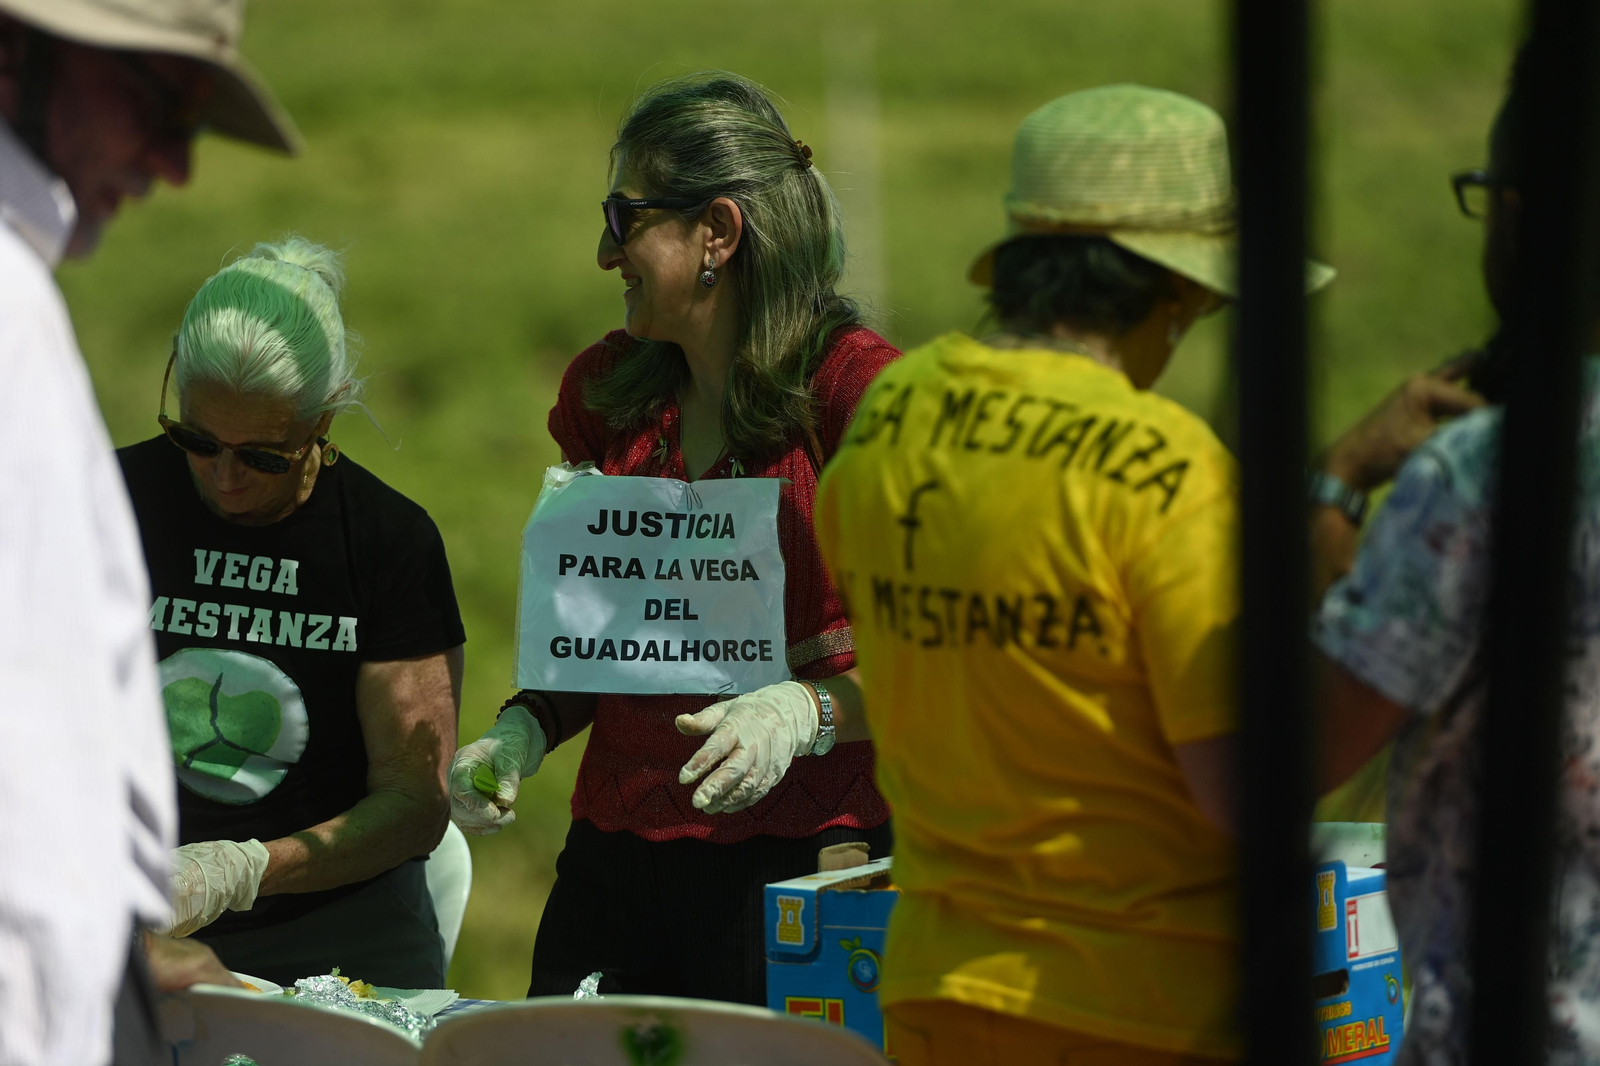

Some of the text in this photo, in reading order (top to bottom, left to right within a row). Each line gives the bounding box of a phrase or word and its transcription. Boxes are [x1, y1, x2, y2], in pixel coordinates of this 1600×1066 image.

[928, 387, 1190, 514] MESTANZA
[586, 508, 736, 540] JUSTICIA
[193, 548, 300, 596] VEGA
[558, 553, 760, 582] PARA LA VEGA
[644, 598, 699, 621] DEL
[550, 636, 773, 662] GUADALHORCE
[1316, 1000, 1352, 1022] TRICOS
[1321, 1015, 1390, 1059] MERAL
